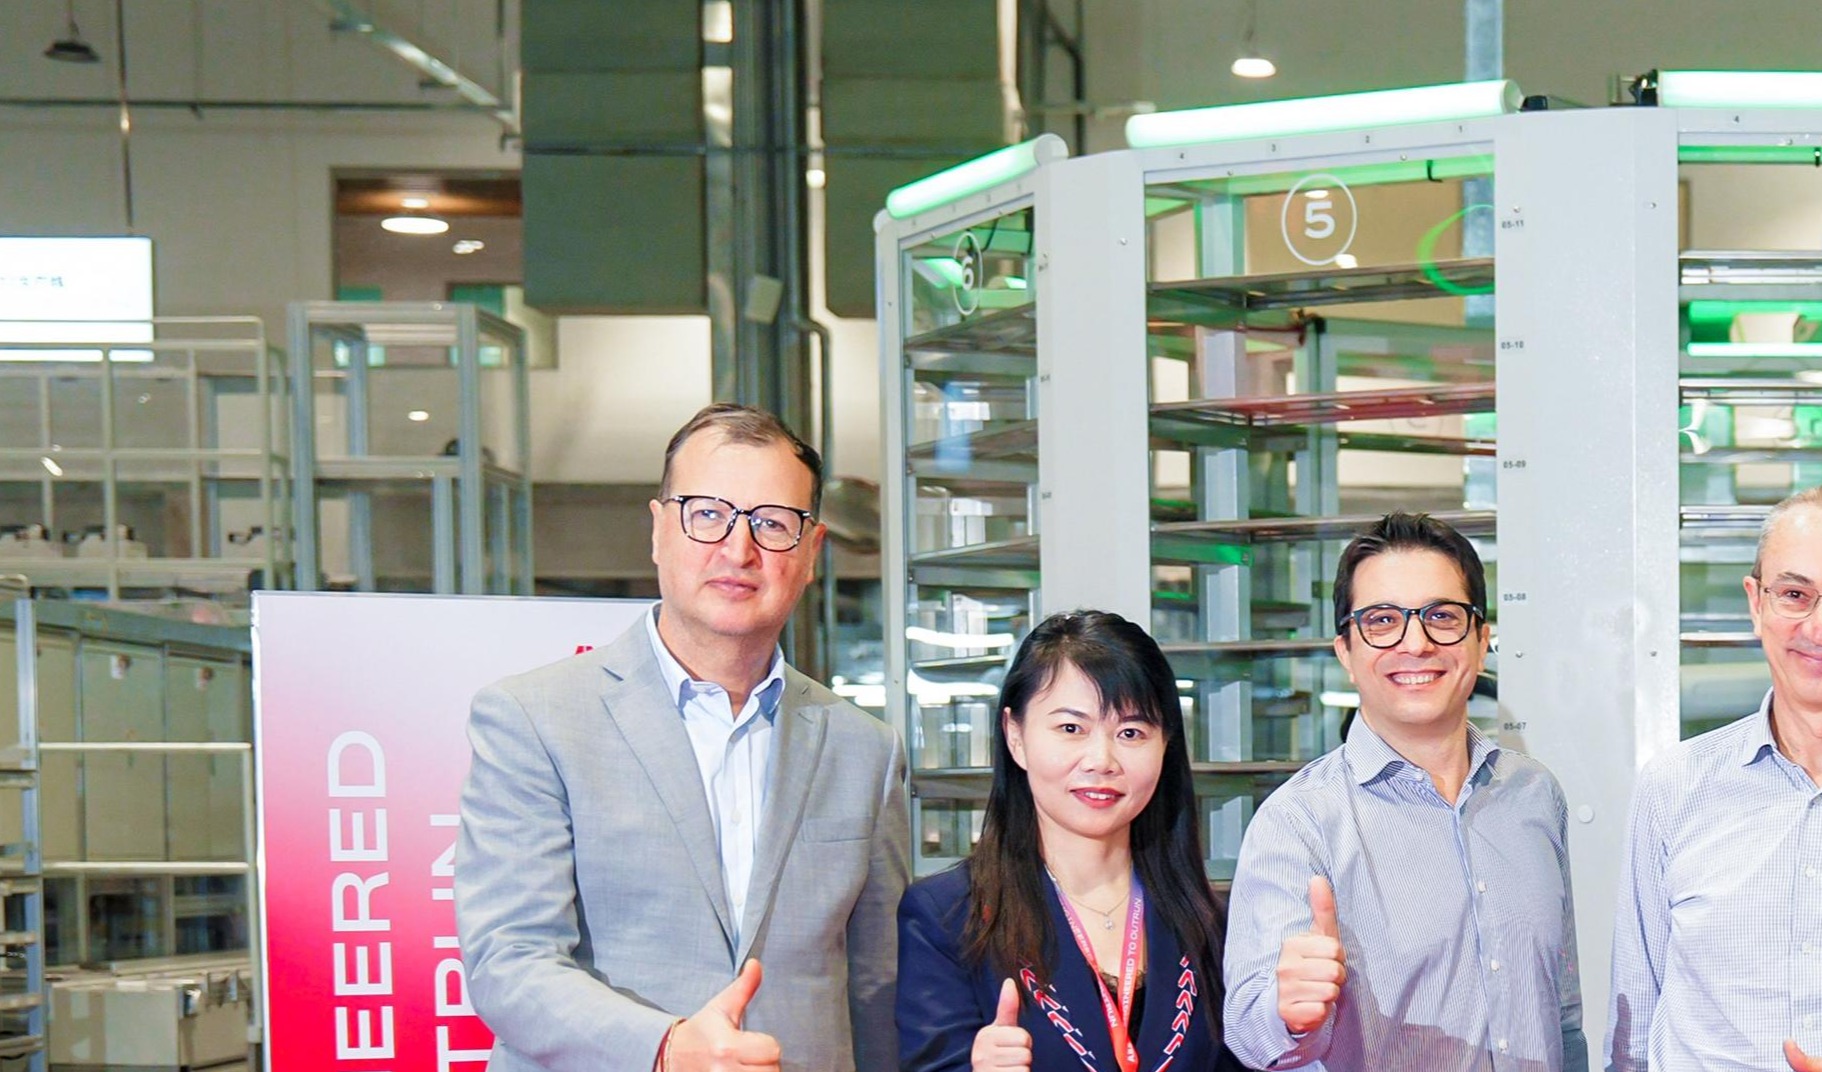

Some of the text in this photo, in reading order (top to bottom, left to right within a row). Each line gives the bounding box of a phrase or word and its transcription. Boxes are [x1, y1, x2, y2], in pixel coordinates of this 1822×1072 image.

[1304, 201, 1336, 239] 5
[1501, 219, 1524, 229] 05-11
[961, 255, 974, 291] 6
[1503, 722, 1527, 731] 05-07
[1131, 897, 1142, 941] OUTRUN
[1127, 942, 1137, 956] TO
